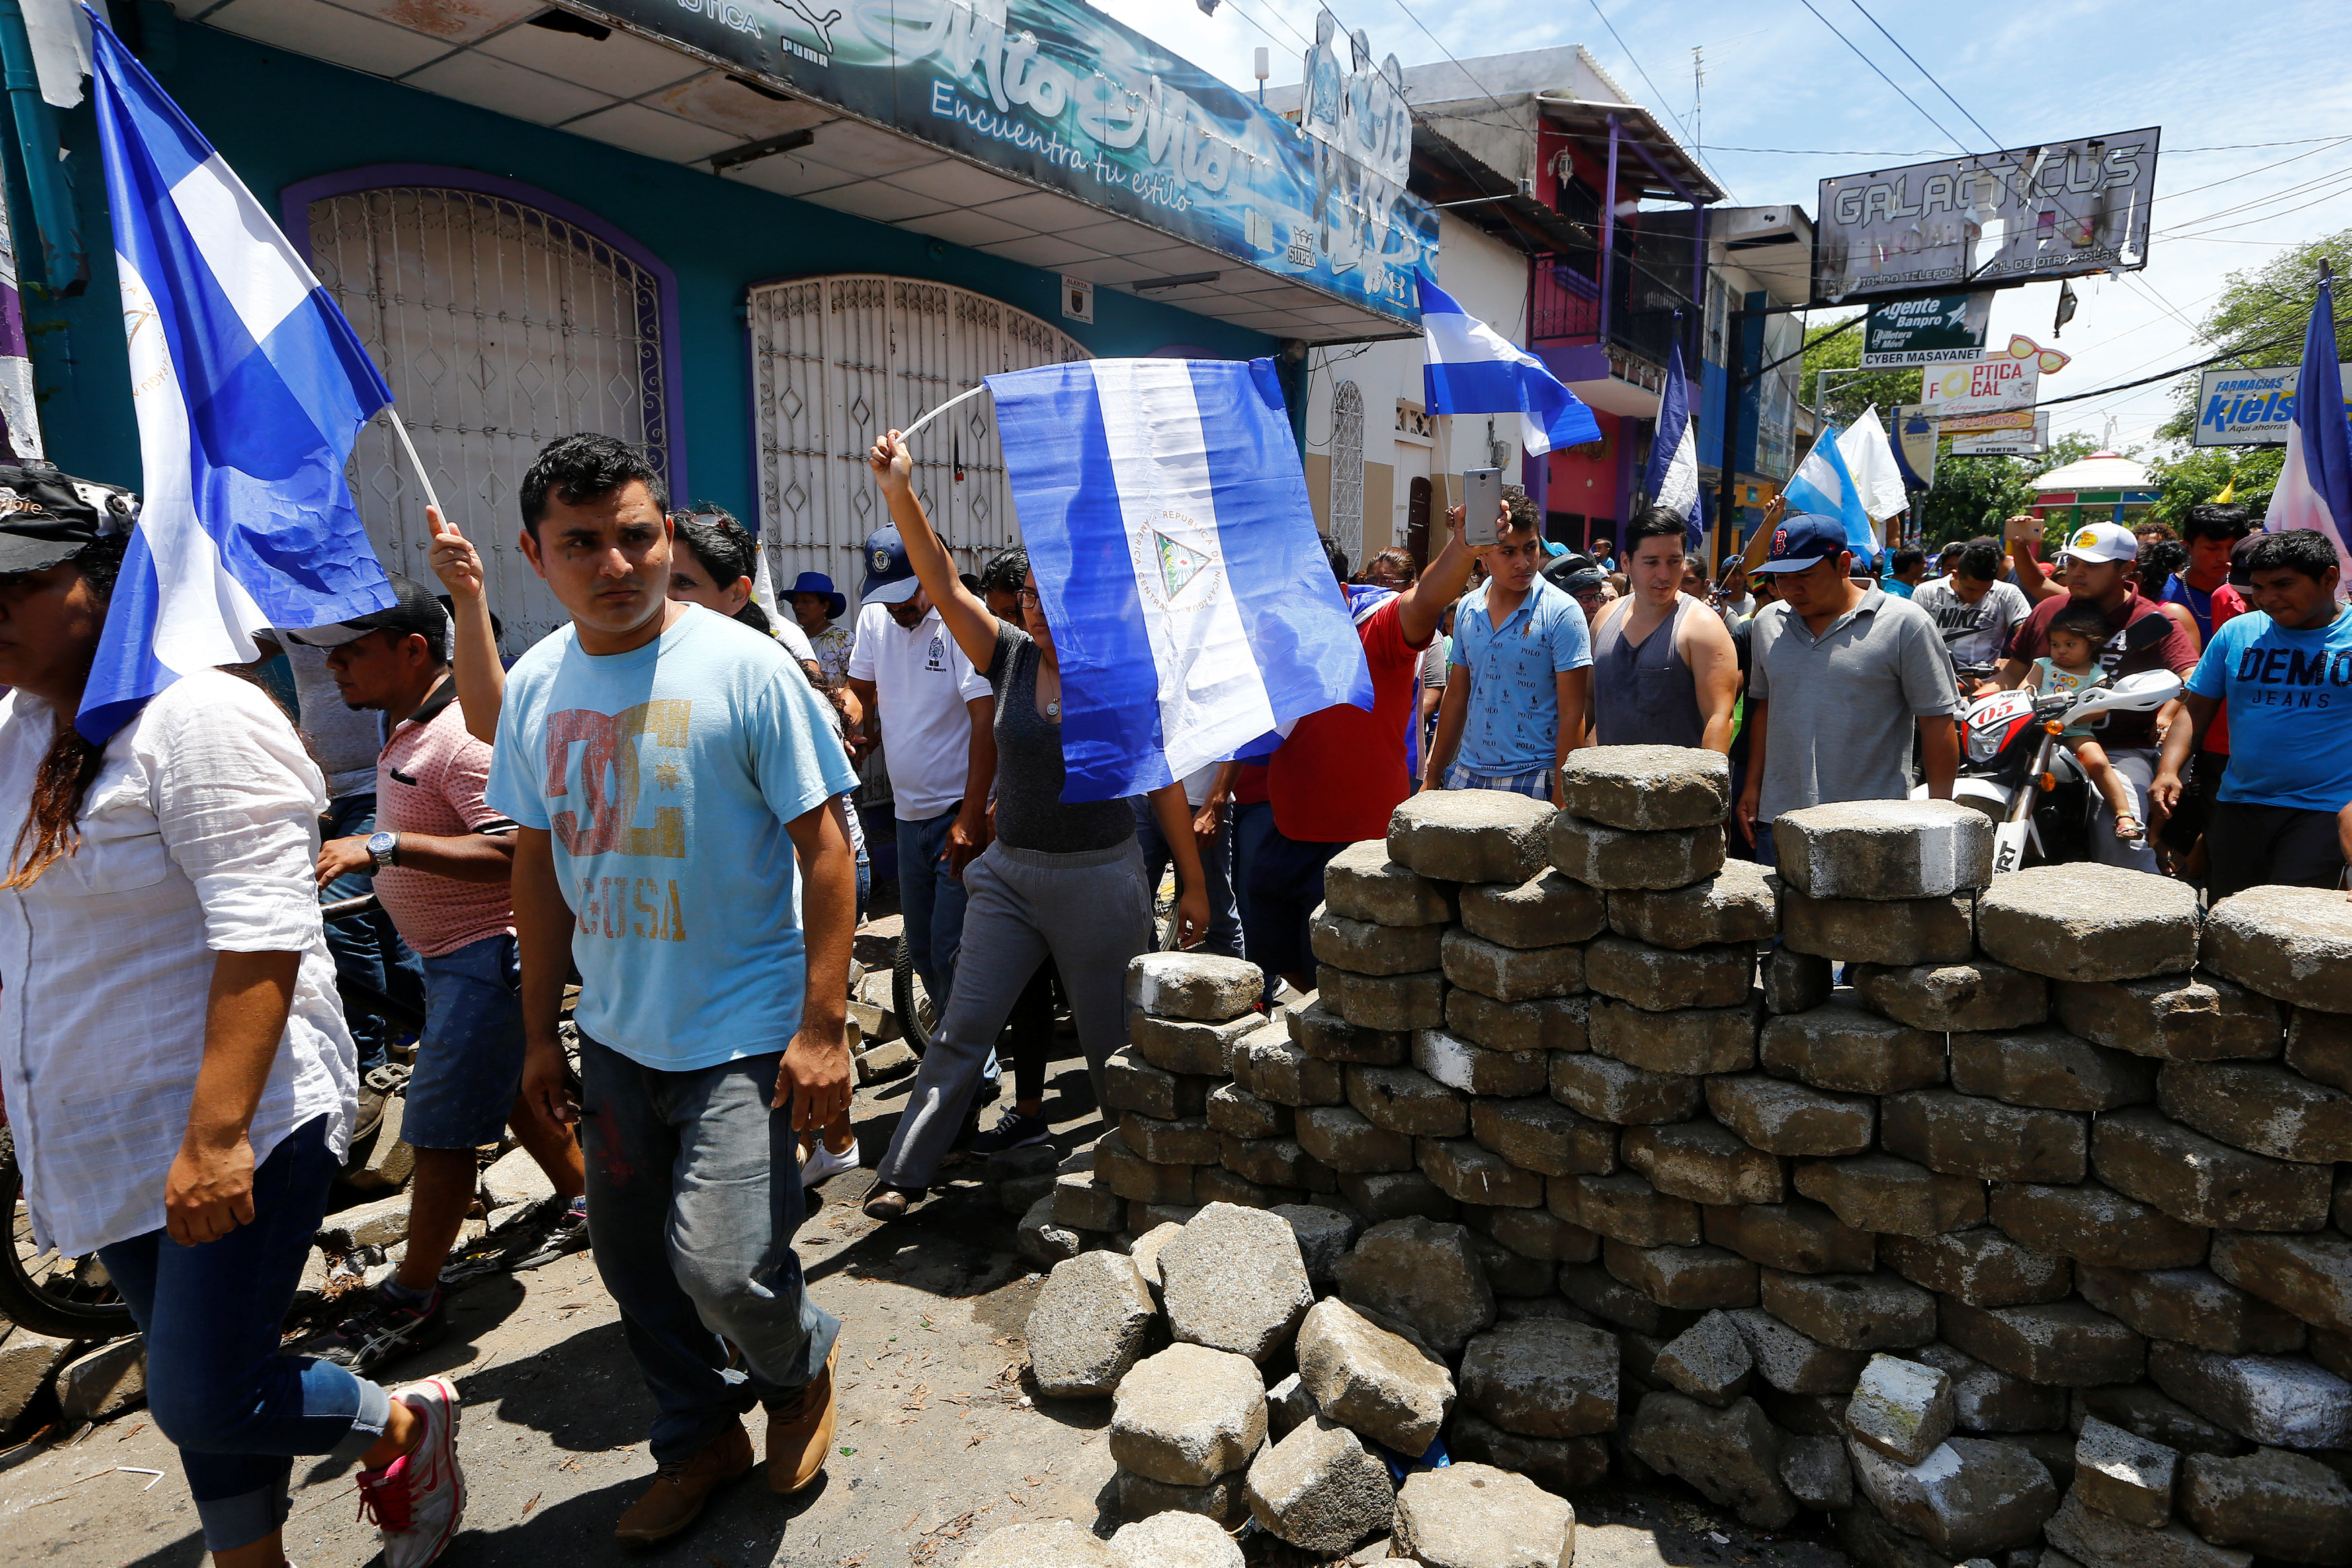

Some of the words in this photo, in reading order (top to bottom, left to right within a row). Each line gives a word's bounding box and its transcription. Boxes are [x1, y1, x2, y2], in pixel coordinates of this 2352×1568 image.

[782, 38, 829, 67] PUMA
[932, 80, 1087, 169] Encuentra
[1094, 151, 1127, 183] tu
[1132, 172, 1193, 212] estilo
[1288, 246, 1316, 268] SUPRA
[2013, 259, 2031, 269] DE
[1066, 278, 1088, 288] ALERTA
[1896, 316, 1943, 329] Banpro
[1865, 353, 1903, 365] CYBER
[1906, 349, 1982, 362] MASAYANET
[2214, 378, 2285, 392] FARMACIAS
[1163, 511, 1213, 546] REPUBLICA
[1134, 518, 1151, 565] AMERICA
[1138, 572, 1170, 613] CENTRAL
[1185, 570, 1221, 613] NICARAGUA
[1936, 607, 1984, 629] NIKE
[1521, 647, 1540, 658] POLO
[2236, 647, 2352, 687] DEMO
[1517, 679, 1536, 689] POLO
[1999, 691, 2023, 699] MRT
[2252, 690, 2330, 709] JEANS
[1978, 699, 2014, 726] 05
[1482, 739, 1497, 747] POLO
[1516, 742, 1536, 750] POLO
[545, 699, 692, 859] DC
